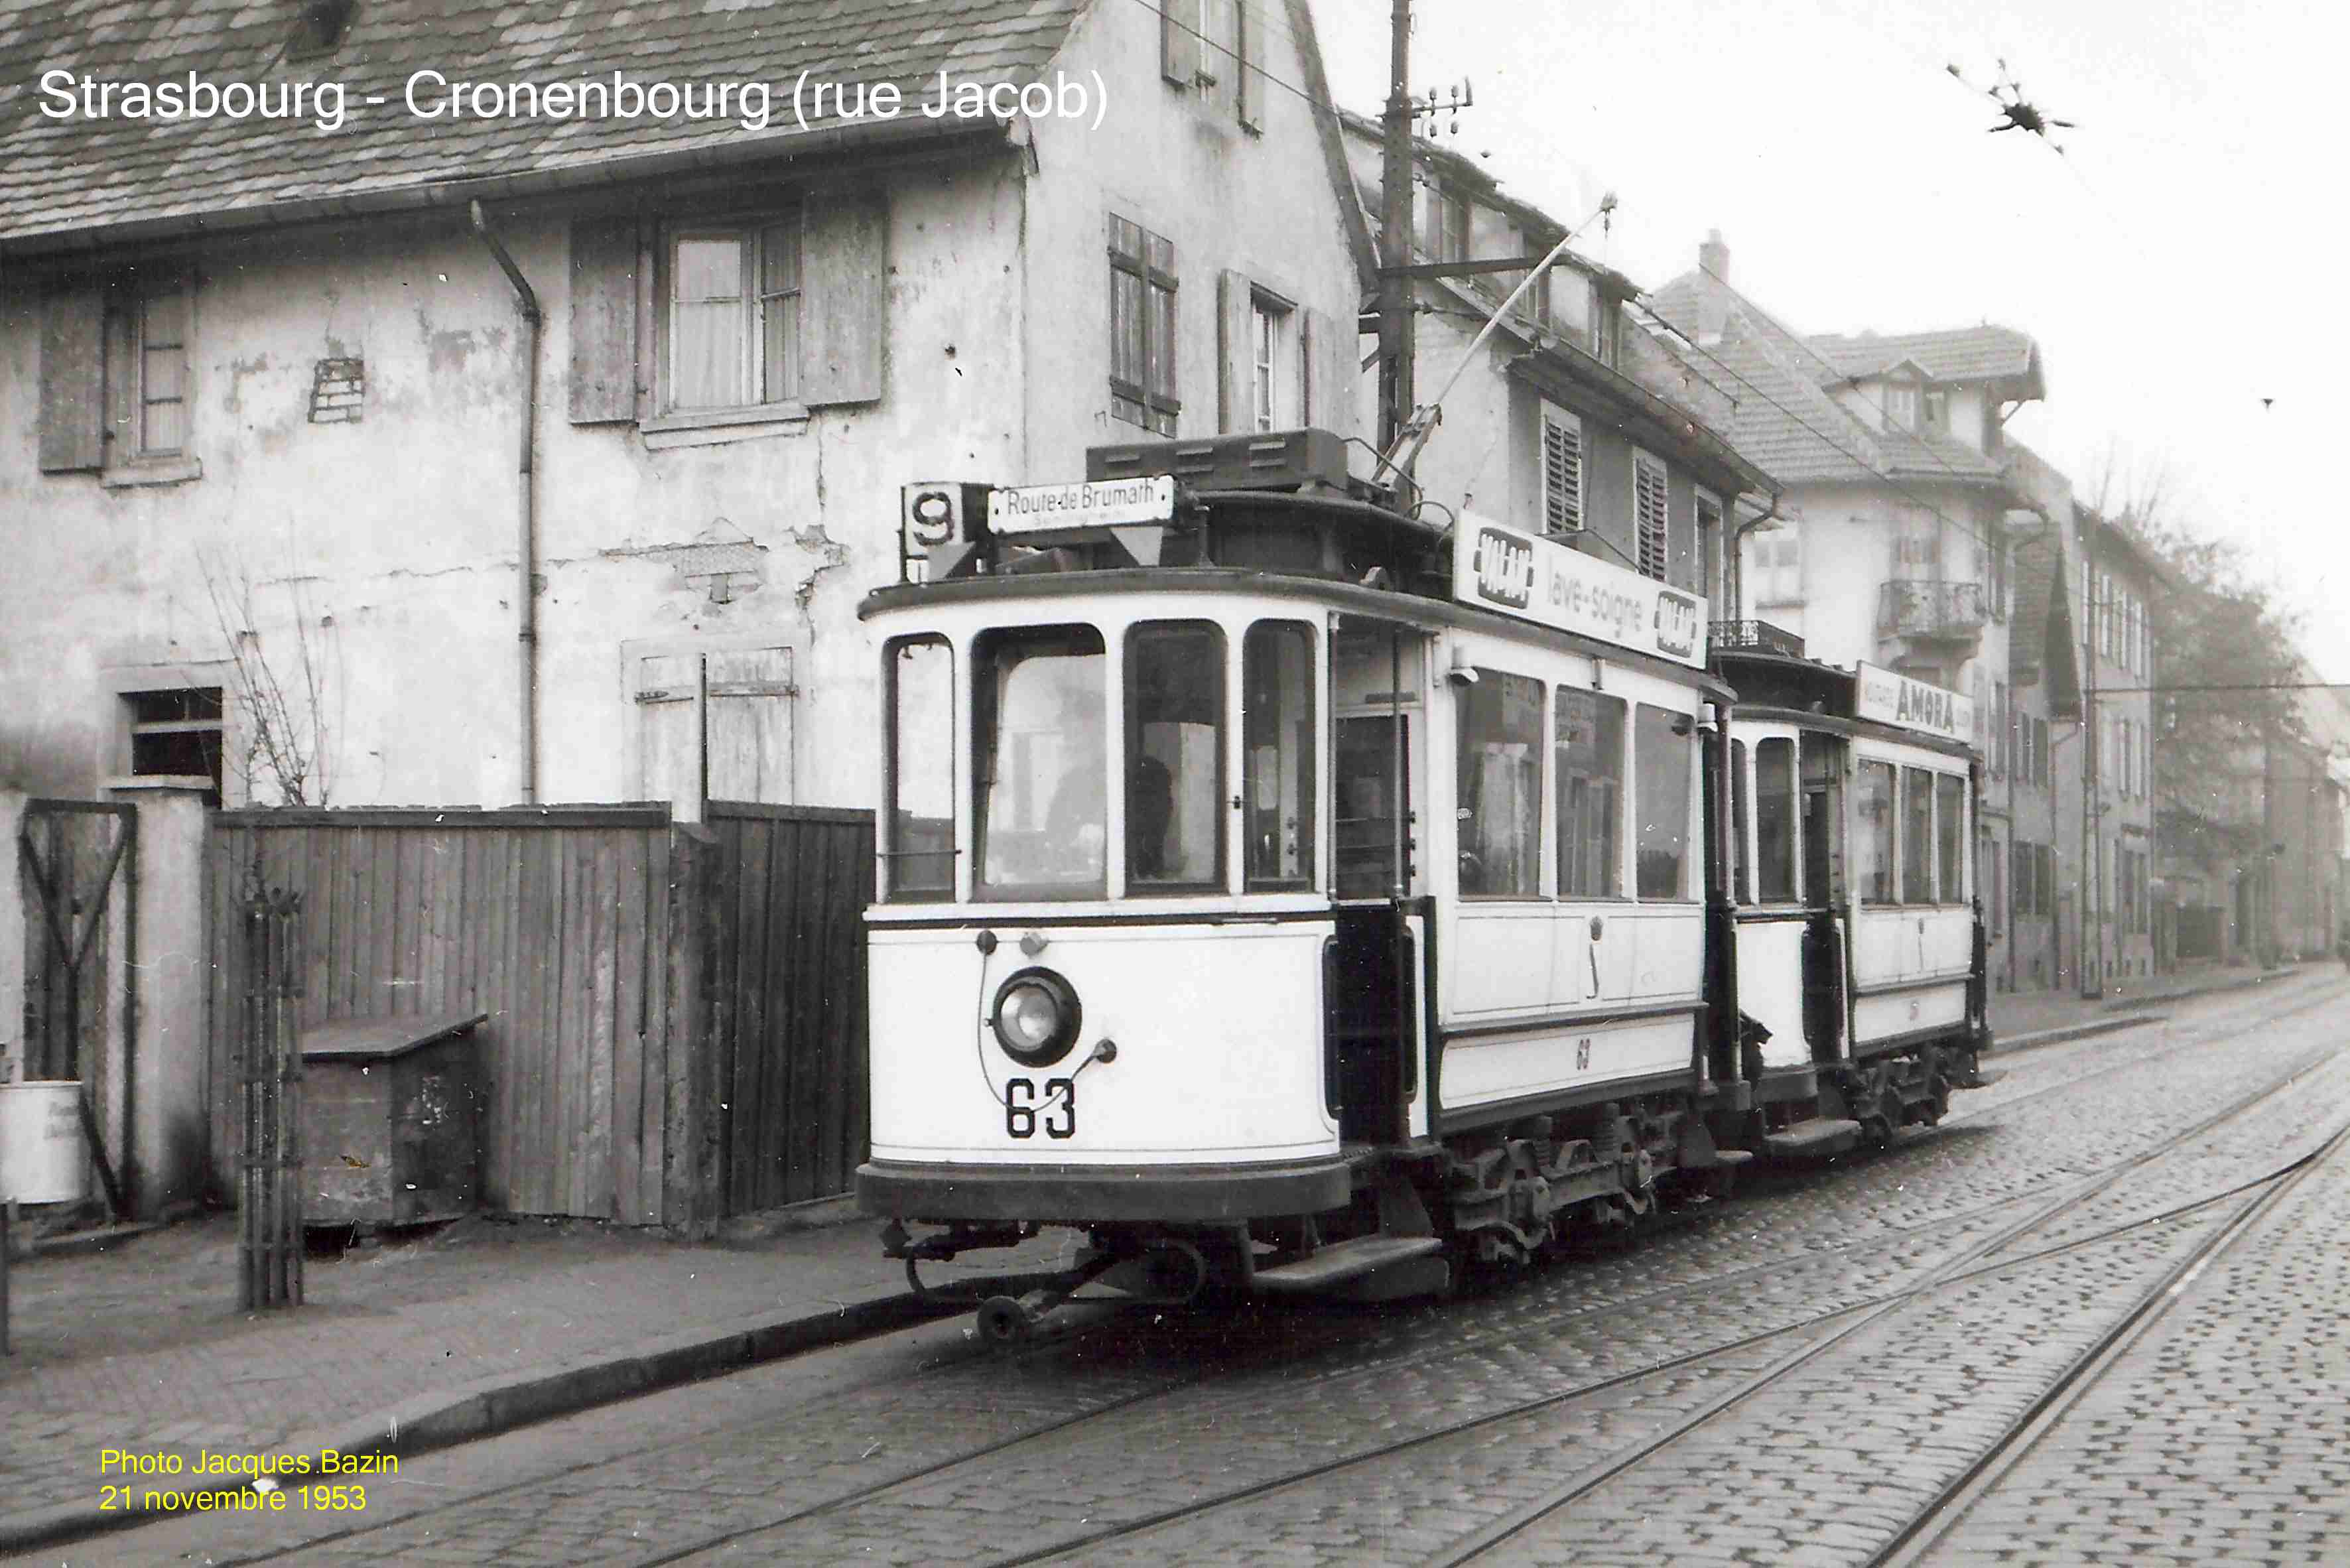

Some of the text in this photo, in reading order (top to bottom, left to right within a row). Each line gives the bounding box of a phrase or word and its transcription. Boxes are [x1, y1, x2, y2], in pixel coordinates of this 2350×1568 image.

[912, 491, 954, 546] 9
[1007, 478, 1154, 515] Route de Brumath
[1896, 680, 1955, 734] AMORA
[1005, 1078, 1077, 1140] 63
